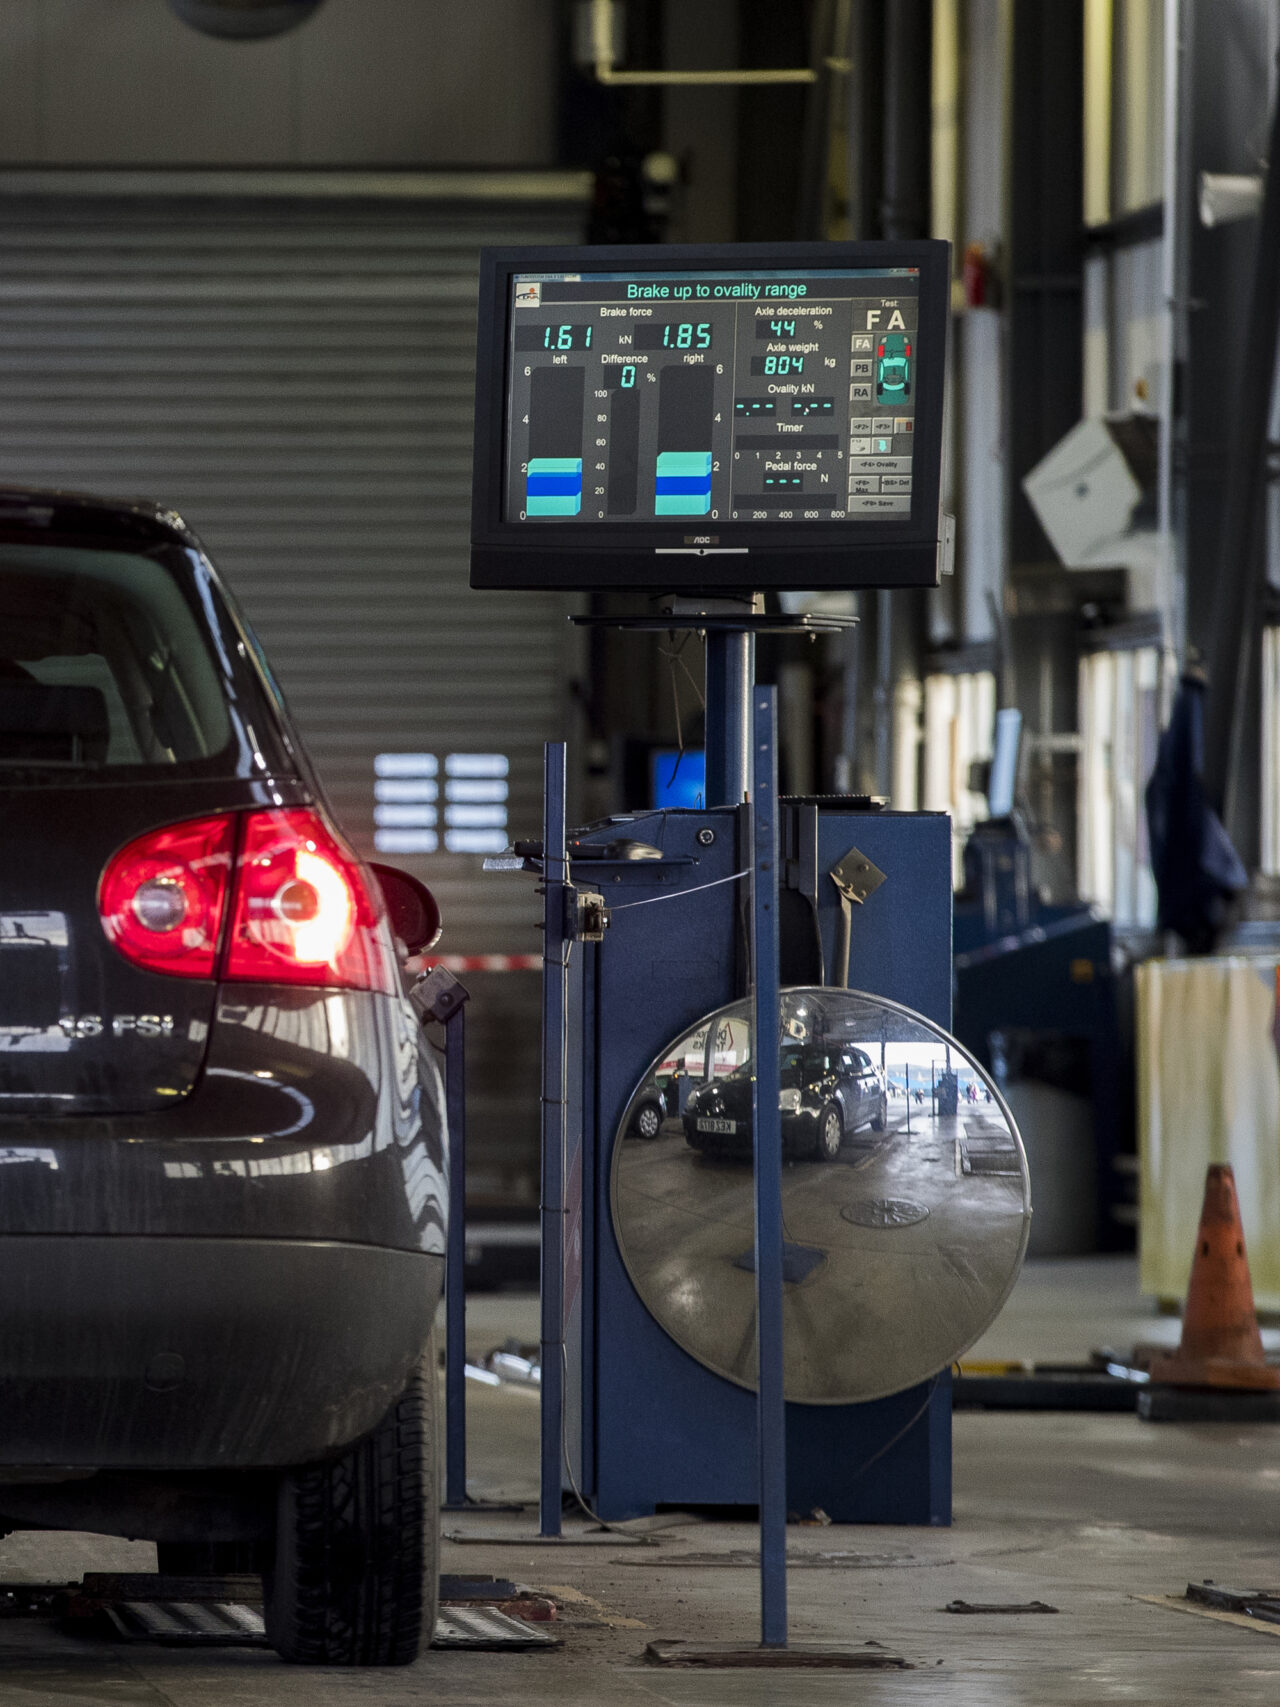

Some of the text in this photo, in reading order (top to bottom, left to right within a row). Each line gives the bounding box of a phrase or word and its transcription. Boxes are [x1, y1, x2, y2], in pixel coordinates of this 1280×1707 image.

[627, 282, 807, 300] Brake up to ovality range
[600, 307, 653, 317] Brake force
[755, 306, 833, 316] Axle deceleration
[770, 320, 796, 336] 44
[813, 320, 824, 330] %
[543, 325, 592, 350] 1.61
[618, 335, 632, 344] kN
[663, 323, 711, 349] 1.85
[766, 342, 819, 354] Axle weight
[855, 339, 871, 349] FA
[552, 354, 568, 364] left
[601, 354, 649, 364] Difference
[683, 353, 705, 365] right
[824, 357, 836, 368] kg
[716, 364, 724, 374] 6
[764, 356, 804, 375] 804
[855, 364, 869, 373] PB
[524, 366, 531, 376] 6
[620, 365, 636, 388] 0
[646, 373, 656, 383] %
[594, 389, 608, 398] 100
[767, 384, 815, 395] Ovality kN
[854, 388, 868, 397] RA
[522, 414, 530, 424] 4
[596, 414, 607, 422] 80
[713, 412, 722, 423] 4
[776, 422, 804, 433] Timer
[595, 438, 607, 447] 60
[734, 451, 843, 459] 0 1 2 3 4 5
[521, 462, 528, 473] 2
[595, 462, 606, 471] 40
[712, 461, 720, 471] 2
[765, 461, 818, 471] Pedal force
[820, 473, 829, 483] N
[594, 486, 605, 495] 20
[519, 510, 527, 520] 0
[598, 510, 604, 519] 0
[711, 509, 719, 519] 0
[732, 510, 846, 519] 0 200 400 600 800
[693, 536, 711, 544] AOC
